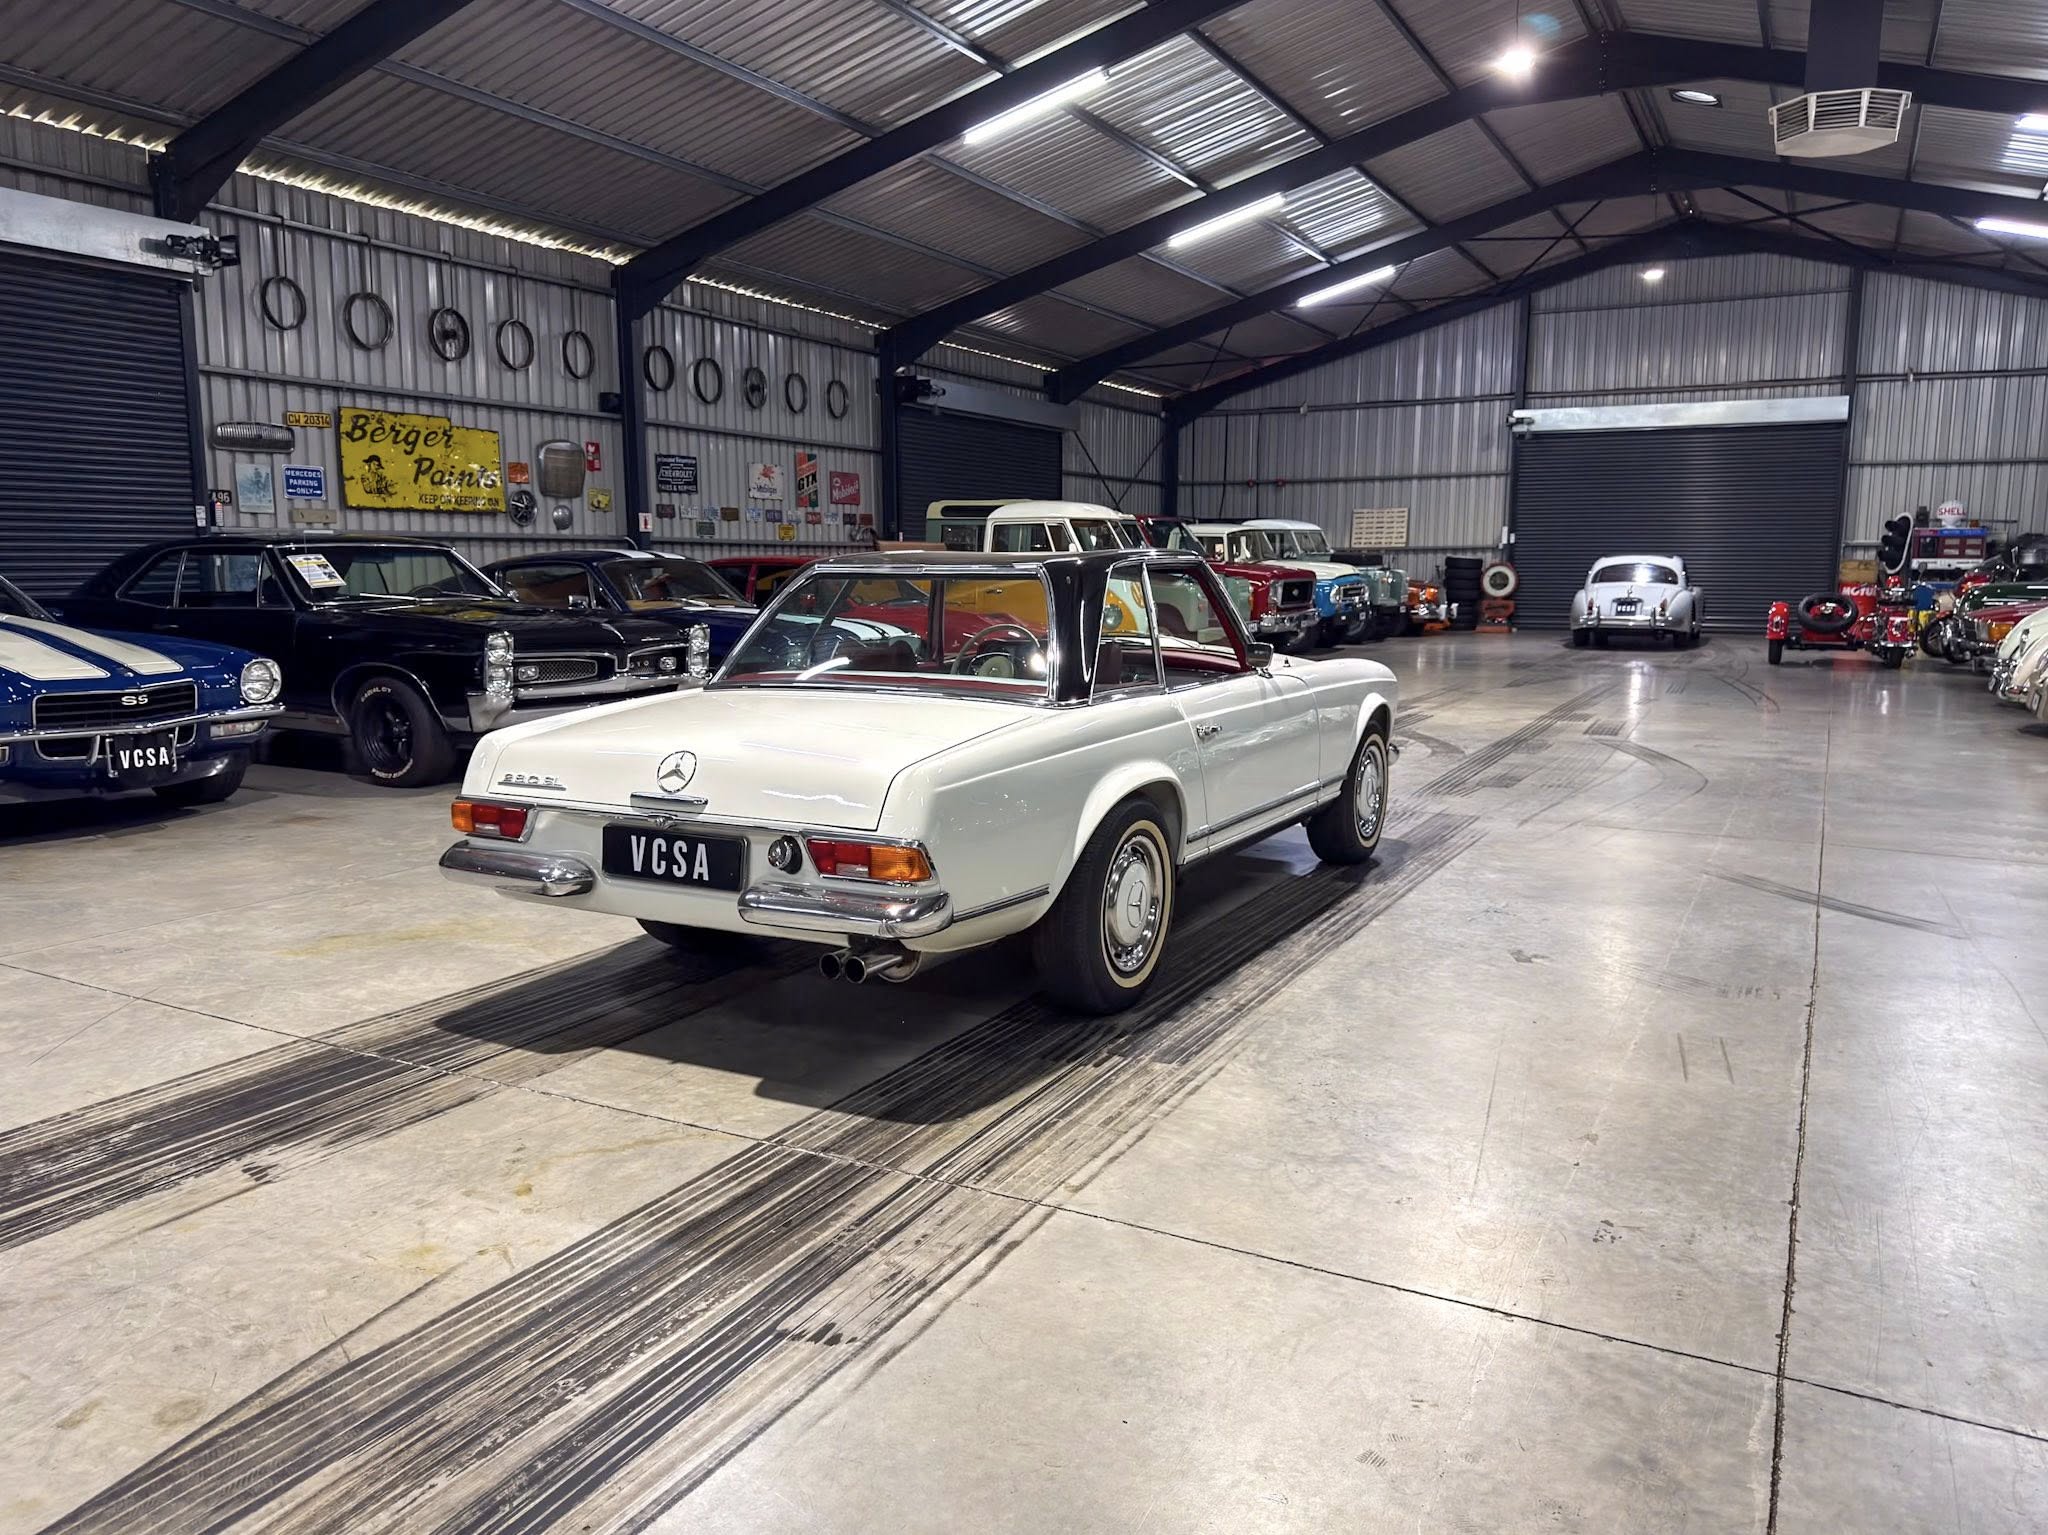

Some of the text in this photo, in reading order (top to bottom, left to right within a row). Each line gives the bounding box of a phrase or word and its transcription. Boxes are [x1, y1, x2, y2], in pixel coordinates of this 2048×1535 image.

[288, 413, 330, 426] CW 20314
[345, 414, 453, 456] Berger
[285, 469, 321, 478] MERCEDES
[413, 457, 498, 489] Paints
[661, 469, 694, 479] CHEVROLET
[289, 478, 319, 487] PARKING
[295, 487, 314, 495] ONLY
[418, 494, 438, 505] KEEP
[1938, 506, 1967, 517] SHELL
[121, 694, 149, 706] SS
[119, 746, 170, 769] VCSA
[630, 834, 710, 882] VCSA
